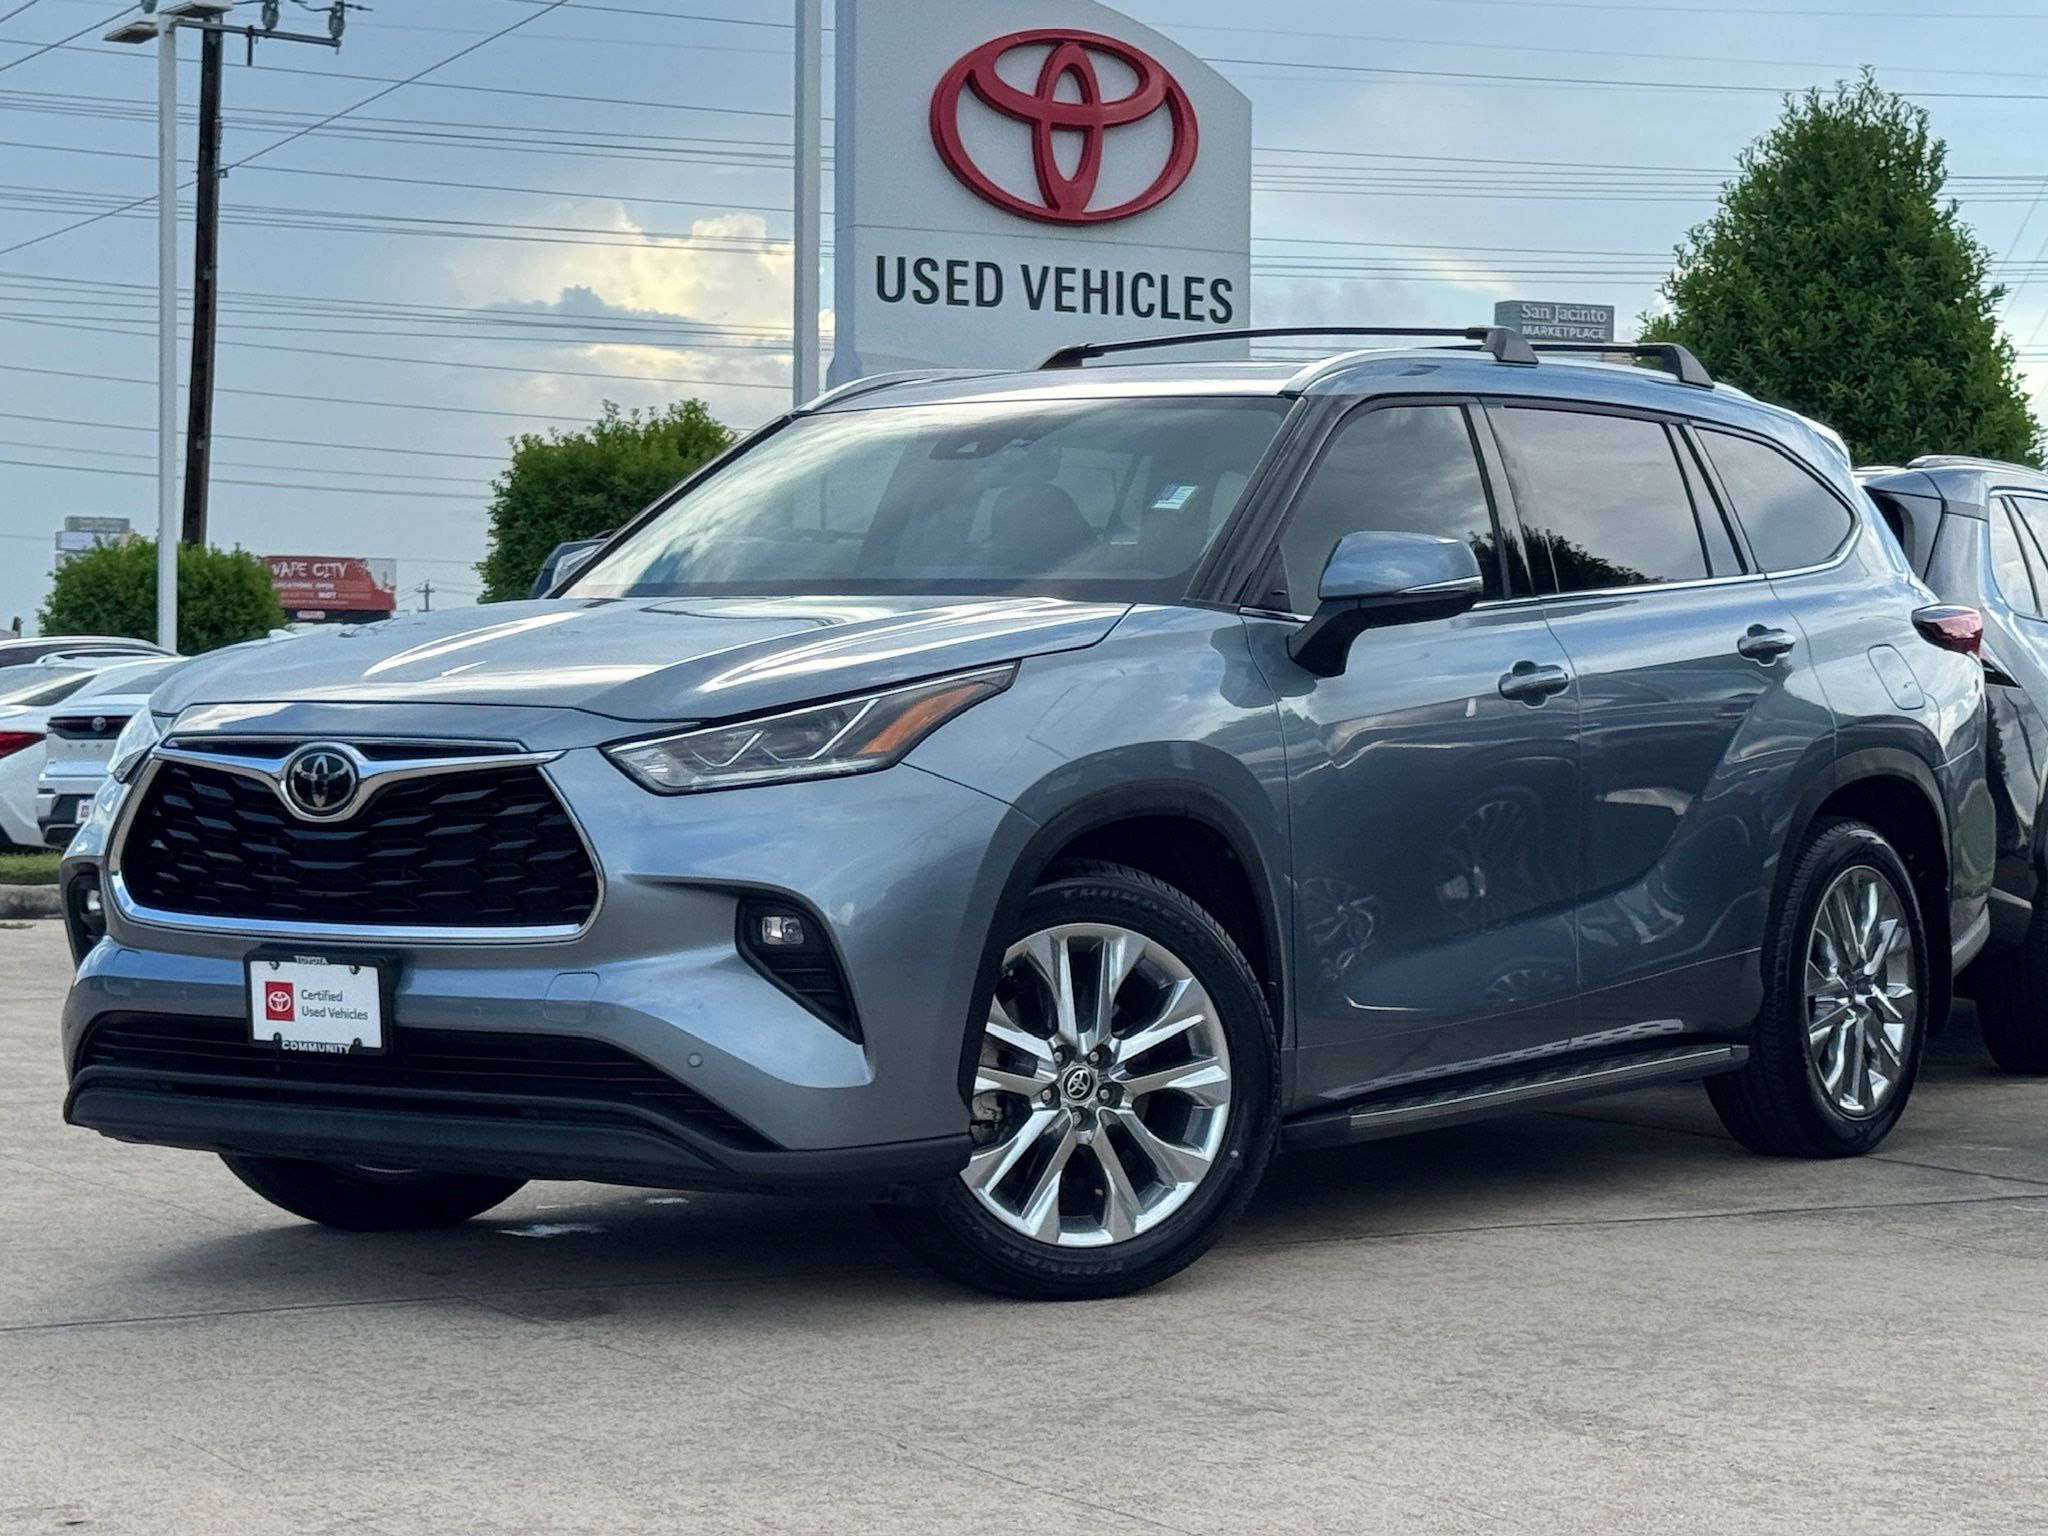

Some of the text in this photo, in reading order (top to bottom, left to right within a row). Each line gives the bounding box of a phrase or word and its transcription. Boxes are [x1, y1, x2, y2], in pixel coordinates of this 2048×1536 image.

[876, 255, 1234, 324] USED VEHICLES
[1521, 303, 1607, 324] San Jacinto
[1521, 325, 1606, 339] MARKETPLACE
[271, 561, 348, 578] VAPE CITY
[294, 955, 329, 965] TOYOTA
[301, 989, 343, 1002] Certified
[301, 1006, 368, 1020] Used Vehicles
[281, 1040, 352, 1054] COMMUNITY
